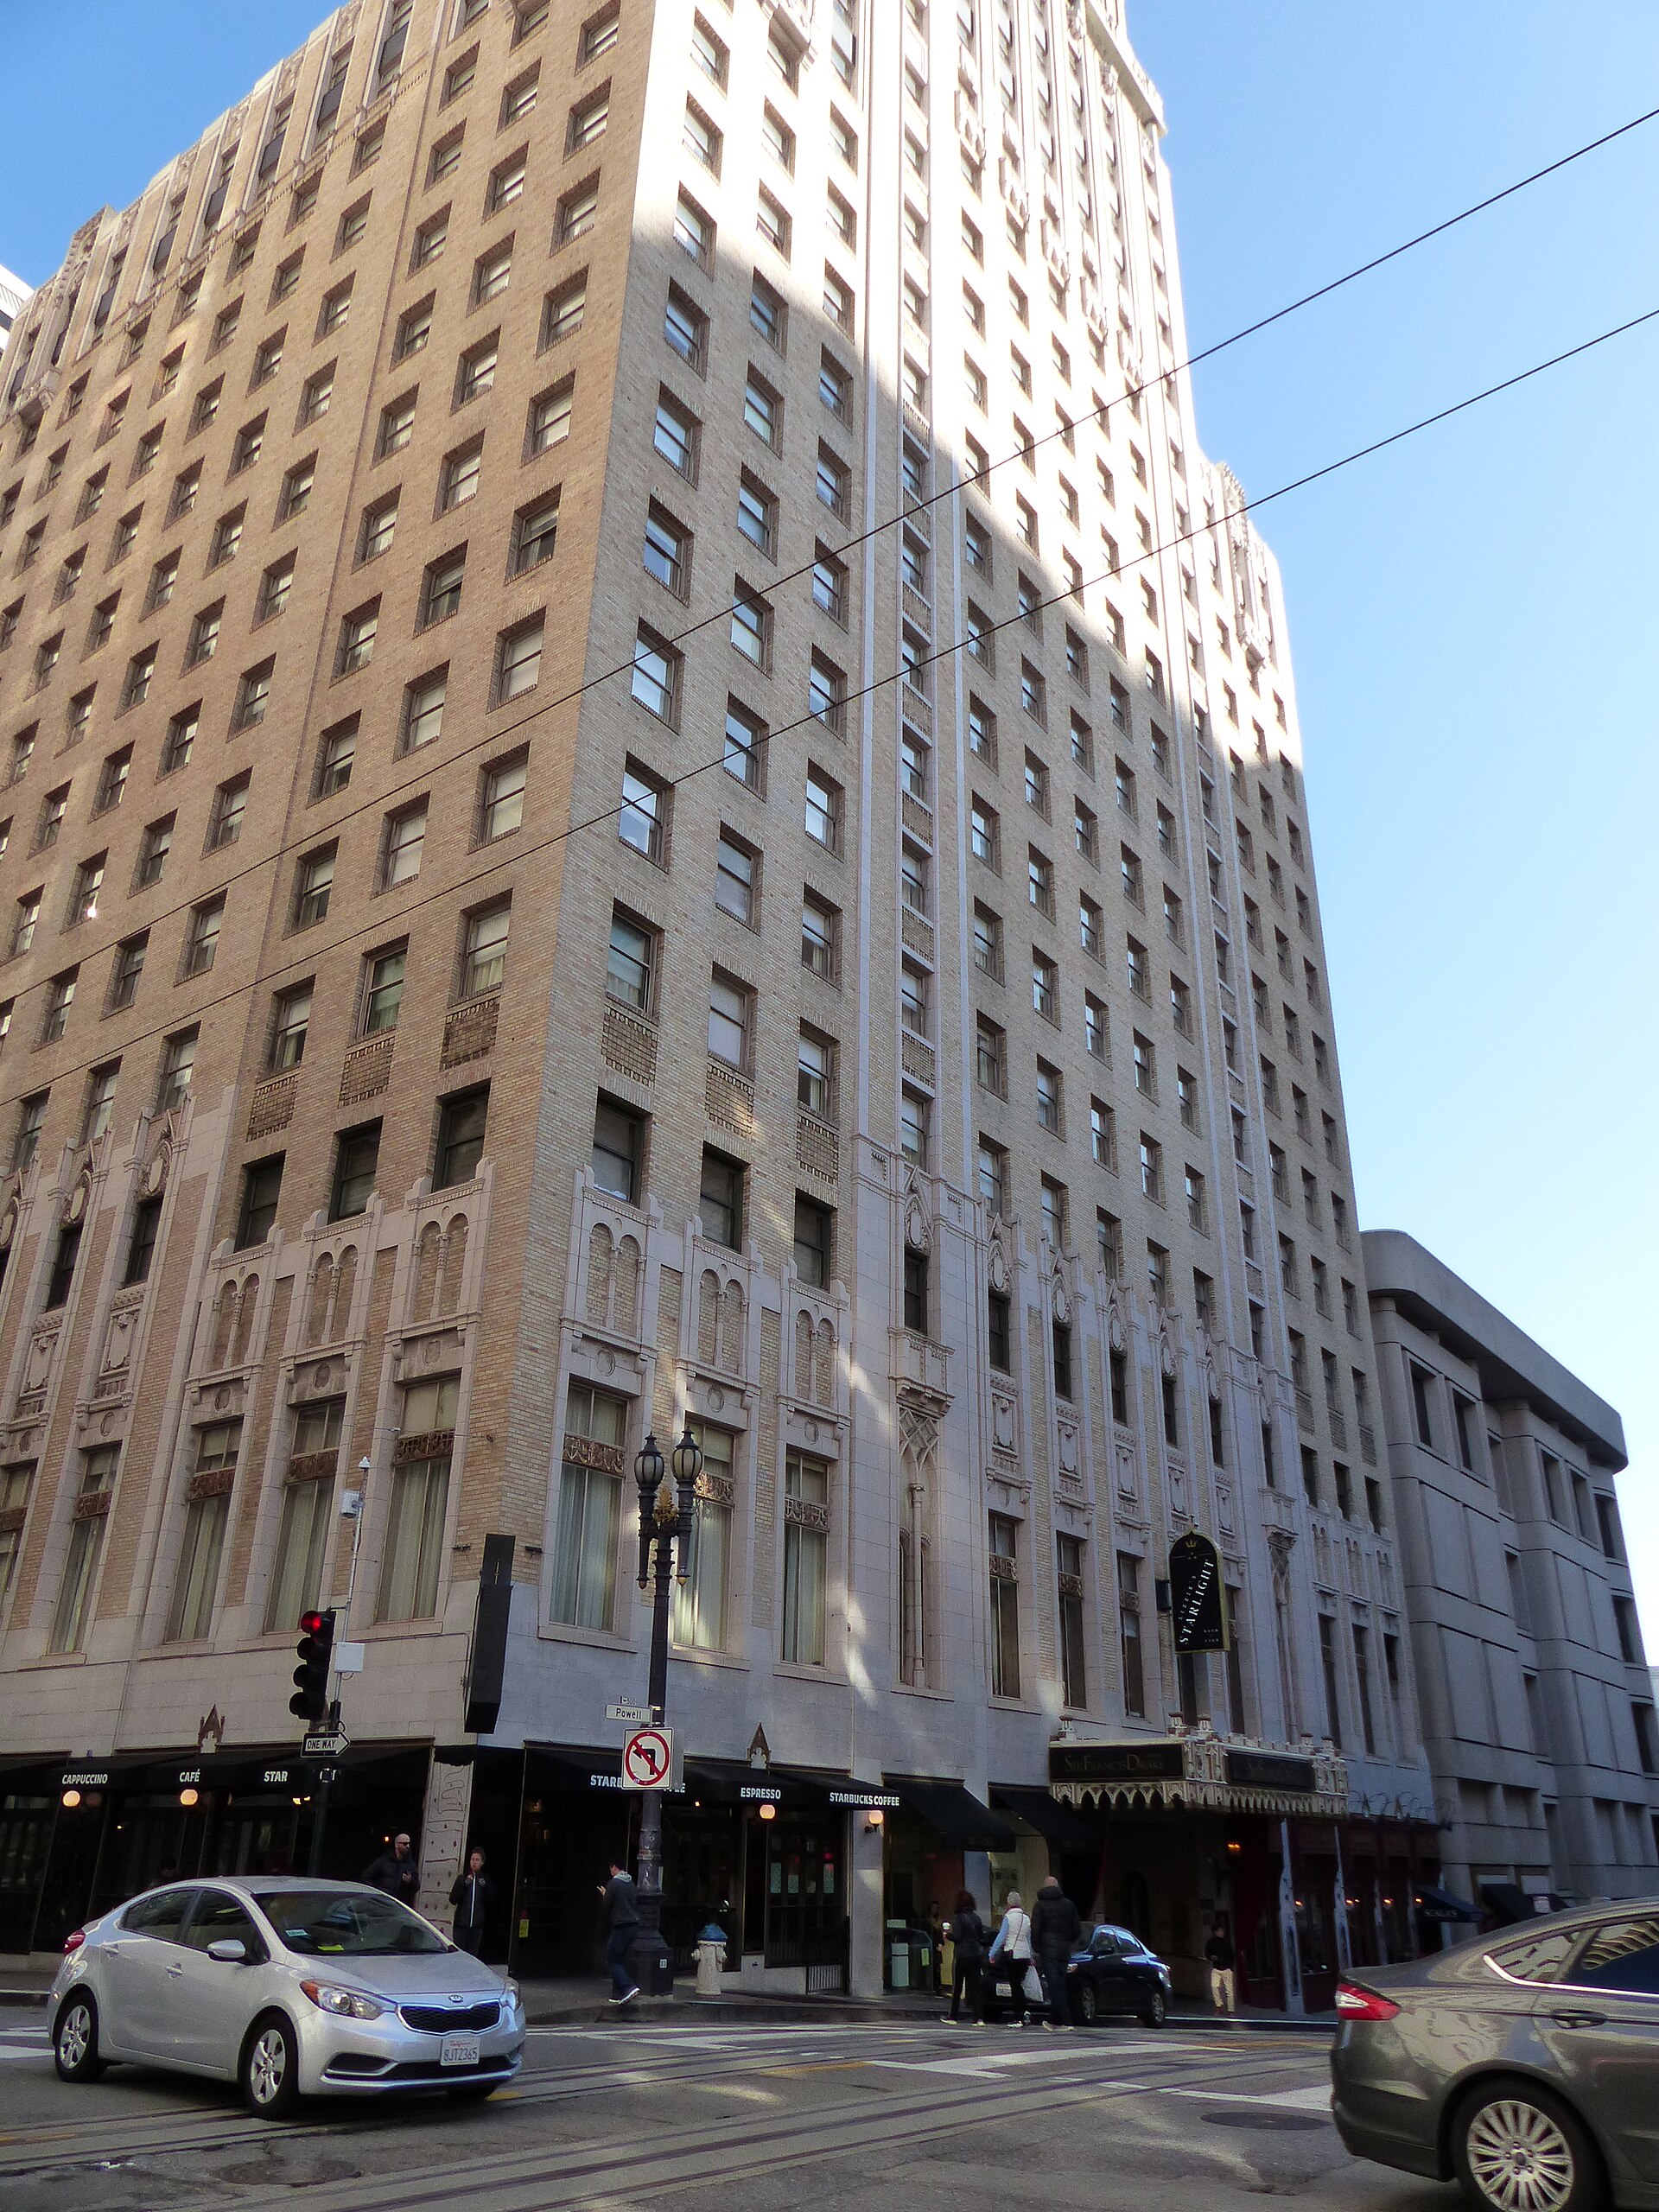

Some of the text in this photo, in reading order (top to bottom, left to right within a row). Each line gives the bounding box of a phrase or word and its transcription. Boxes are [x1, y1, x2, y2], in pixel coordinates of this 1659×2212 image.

[1179, 1559, 1214, 1644] STARLIGHT
[615, 1707, 642, 1719] Powell
[307, 1738, 337, 1750] ONE WAY
[61, 1773, 109, 1785] CAPPUCCINO
[179, 1768, 200, 1783] CAFÉ
[740, 1787, 781, 1800] ESPRESSO
[829, 1791, 900, 1807] STARBUCKS COFFEE
